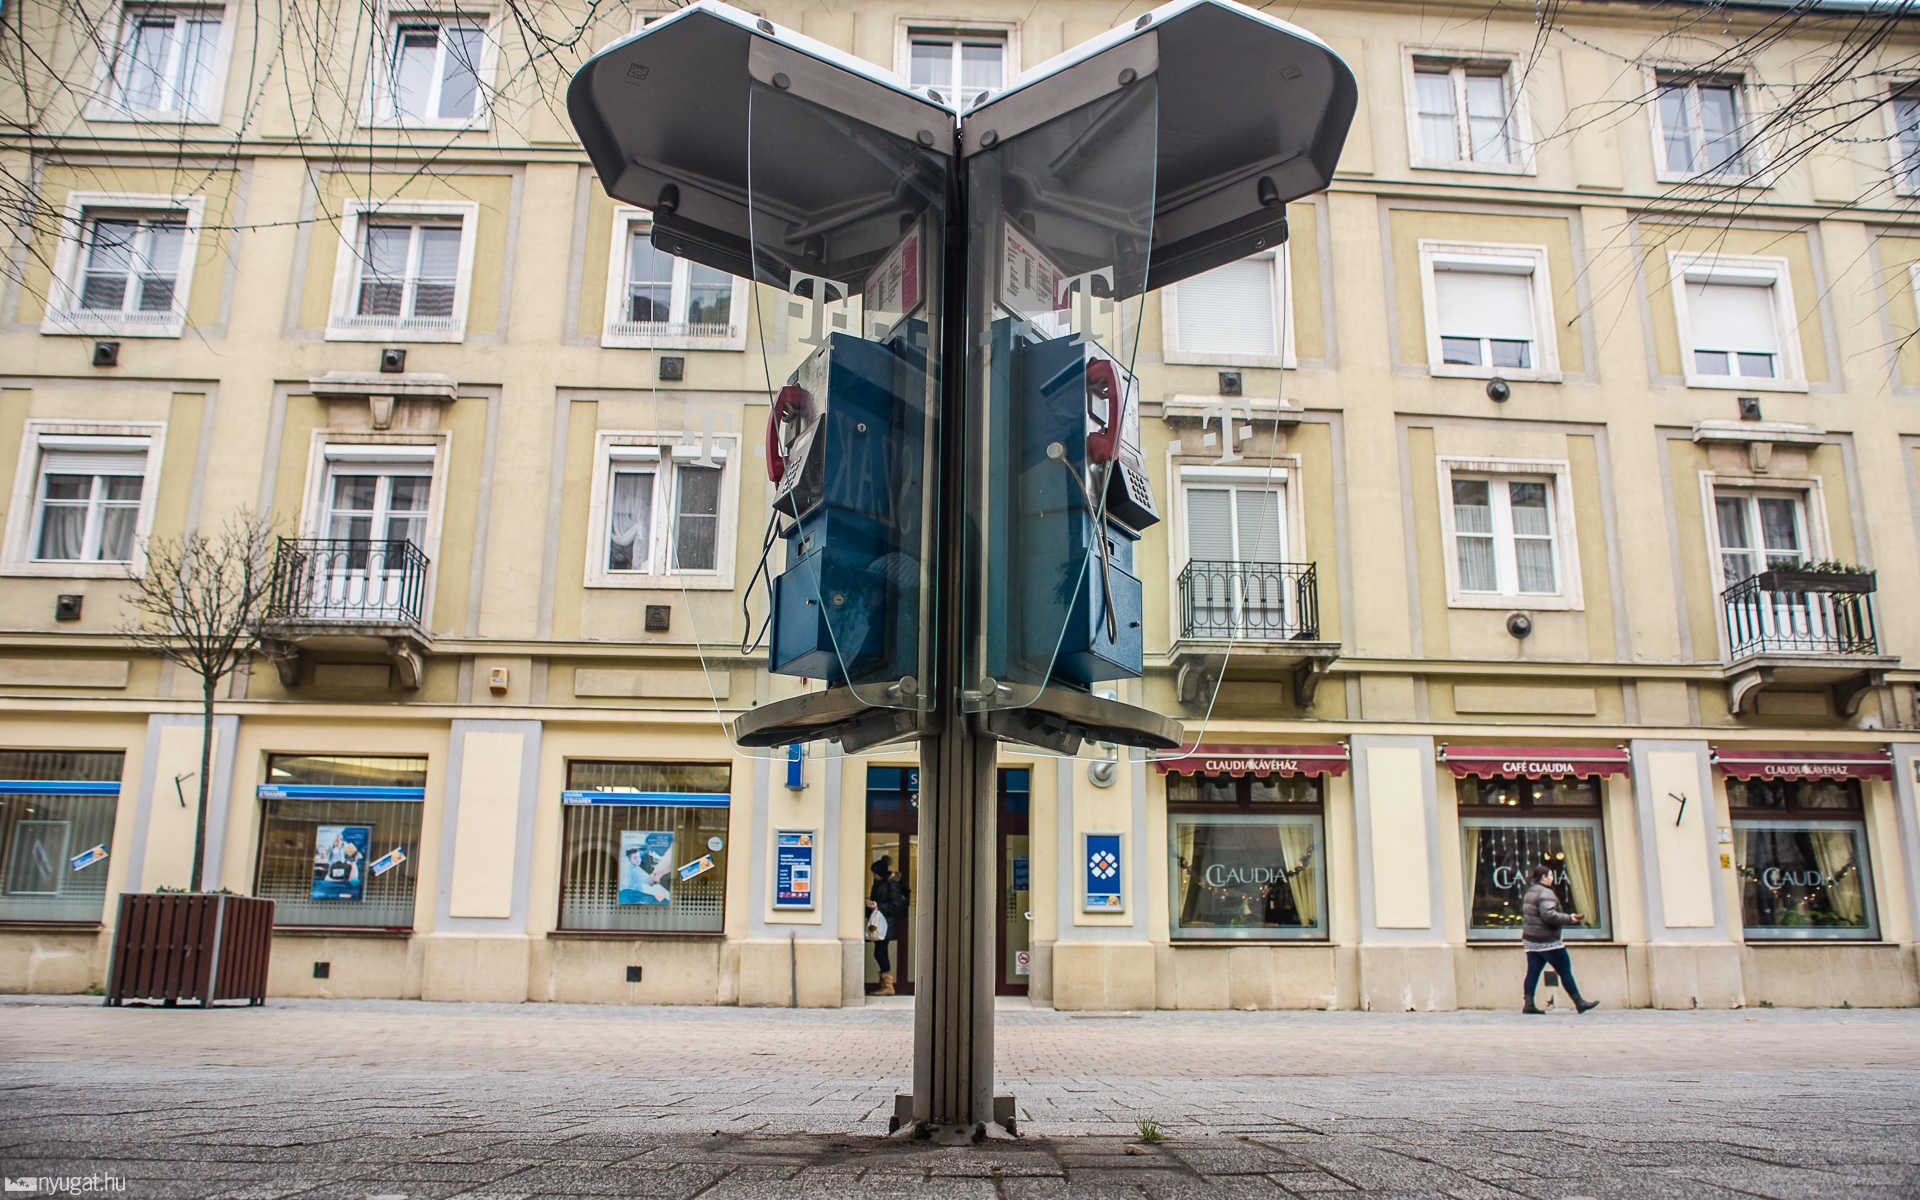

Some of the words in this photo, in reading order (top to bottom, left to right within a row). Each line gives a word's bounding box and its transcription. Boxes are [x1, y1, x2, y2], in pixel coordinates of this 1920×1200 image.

[1205, 760, 1250, 770] CLAUDIA
[1253, 759, 1298, 770] KÁVÉHÁZ
[1502, 761, 1528, 772] CAFÉ
[1528, 763, 1574, 773] CLAUDIA
[1206, 863, 1288, 887] CLAUDIA
[1493, 865, 1571, 889] CLAIA
[1763, 866, 1838, 889] CLAUDIA
